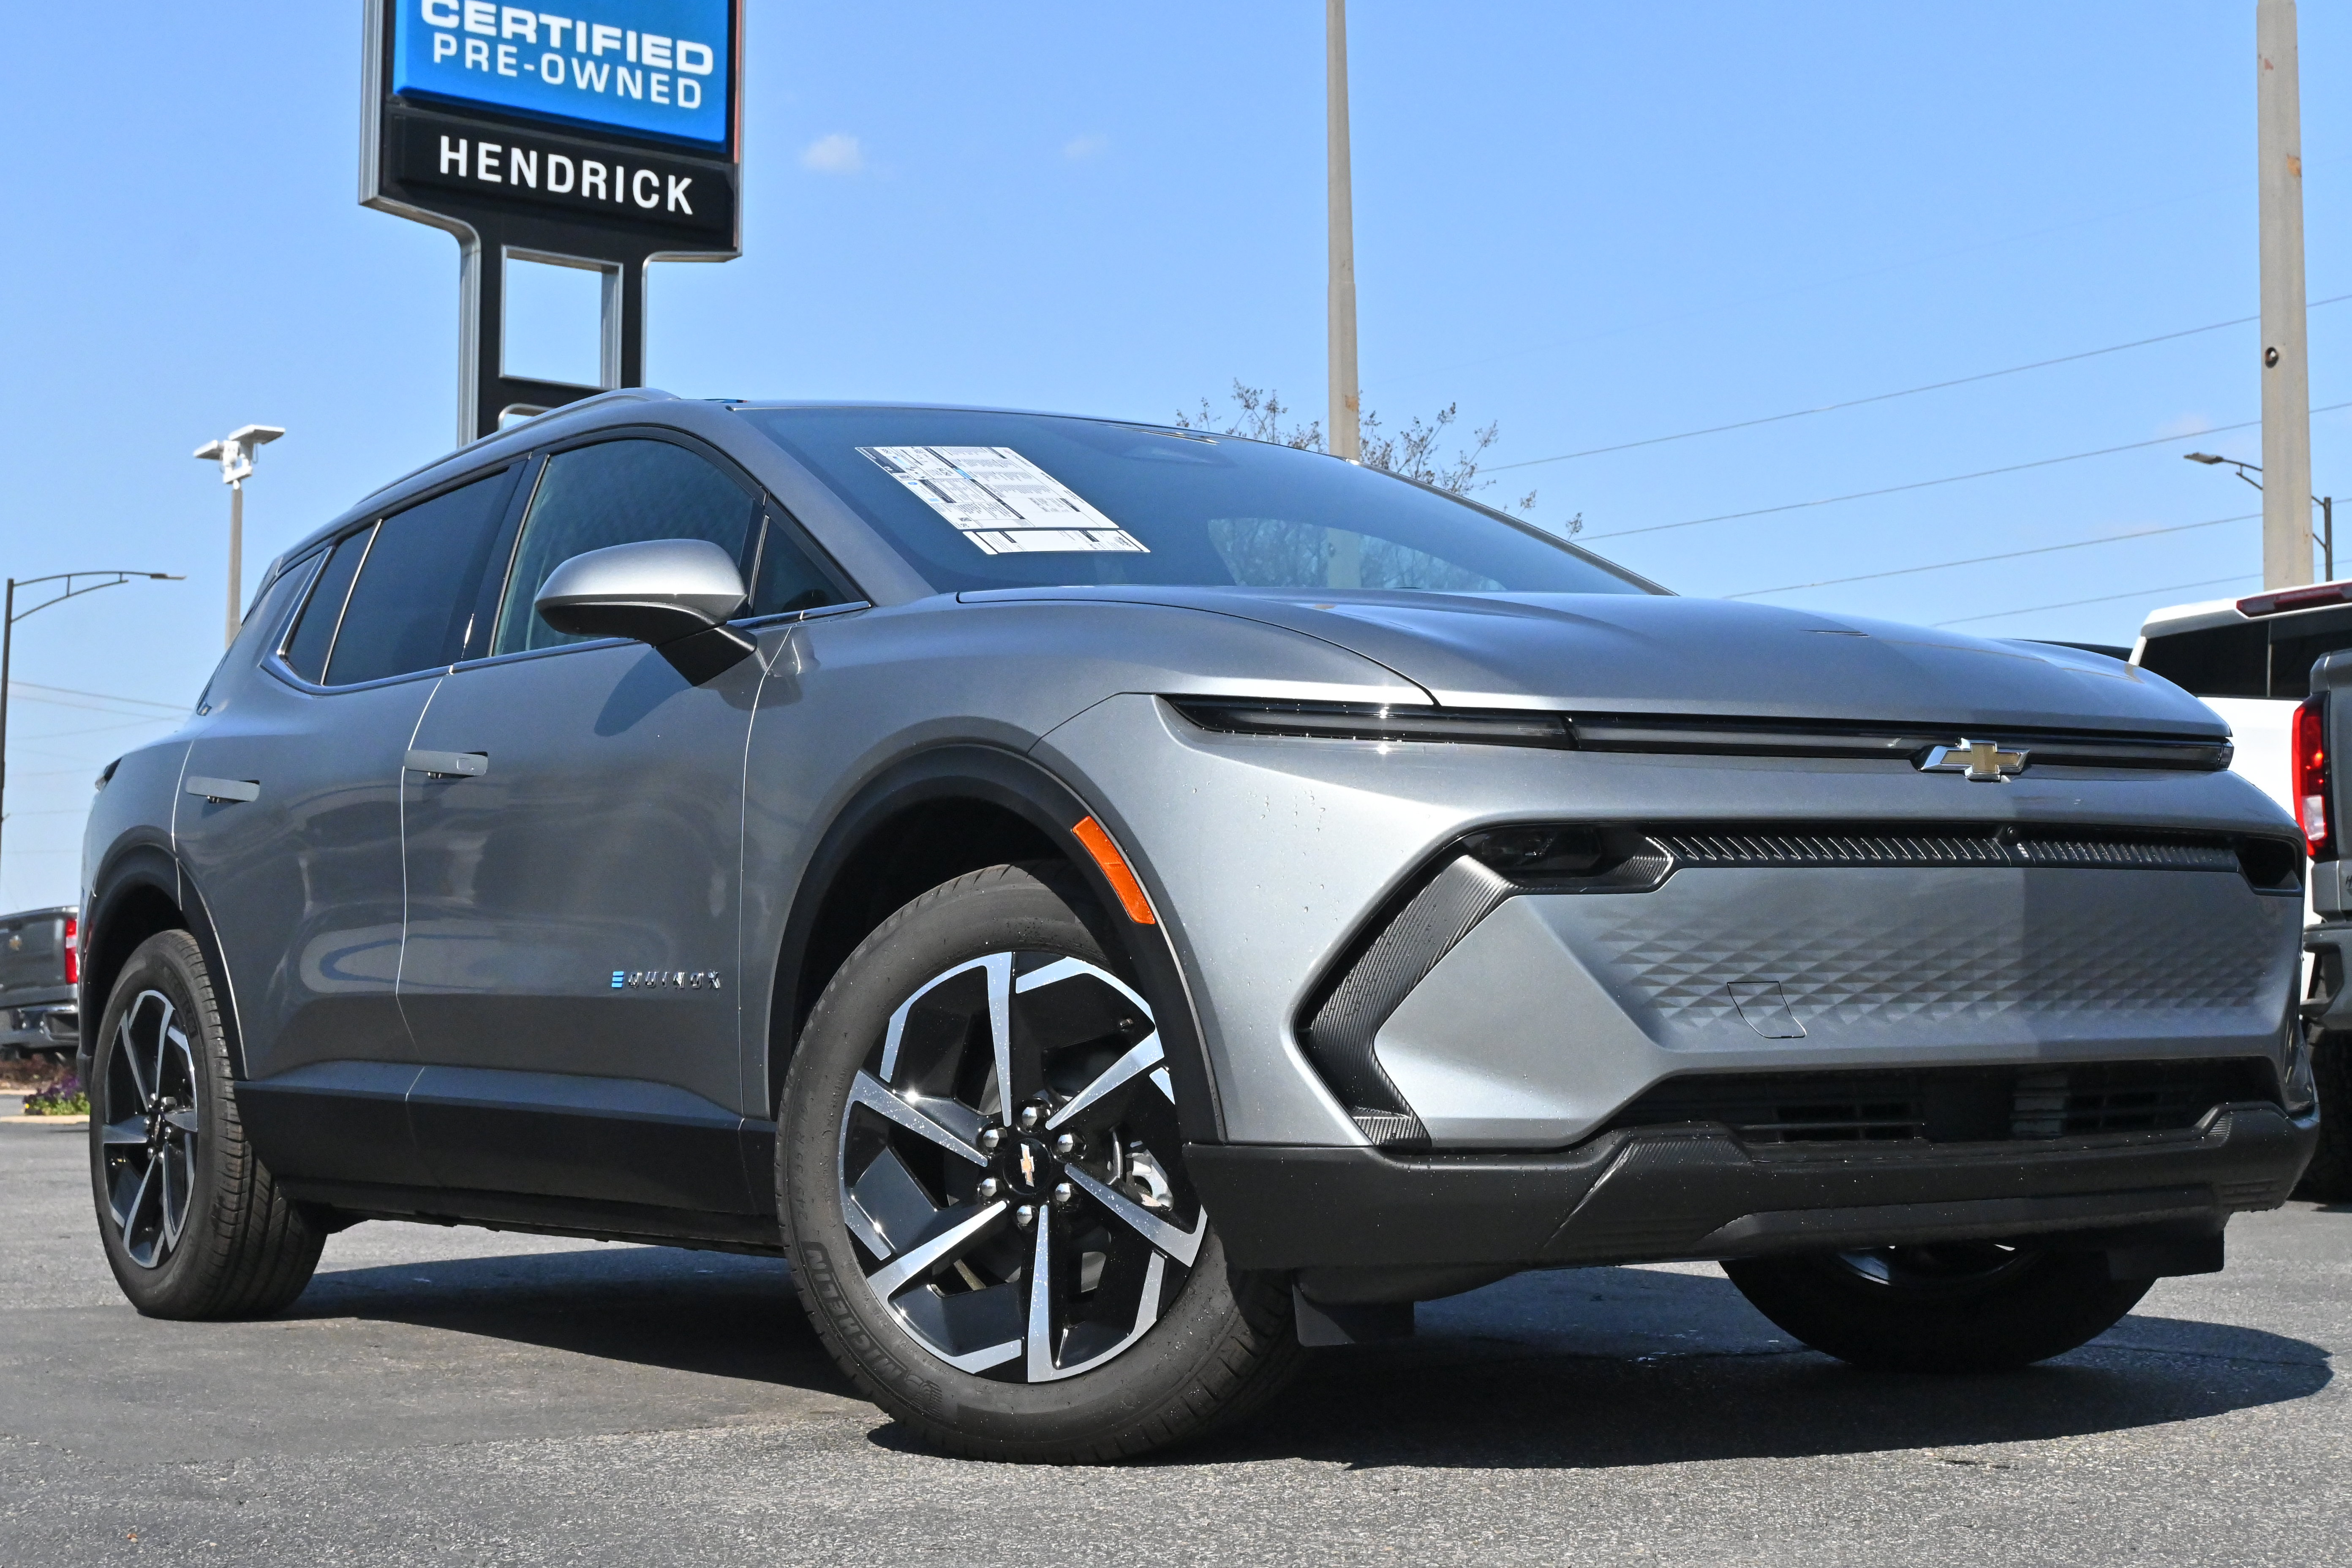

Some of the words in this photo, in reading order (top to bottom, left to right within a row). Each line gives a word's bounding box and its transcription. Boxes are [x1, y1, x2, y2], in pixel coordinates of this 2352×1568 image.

[421, 0, 714, 76] CERTIFIED
[433, 32, 702, 109] PRE-OWNED
[440, 135, 694, 215] HENDRICK
[611, 970, 721, 989] EQUINOX
[805, 1248, 906, 1383] MICHELIN
